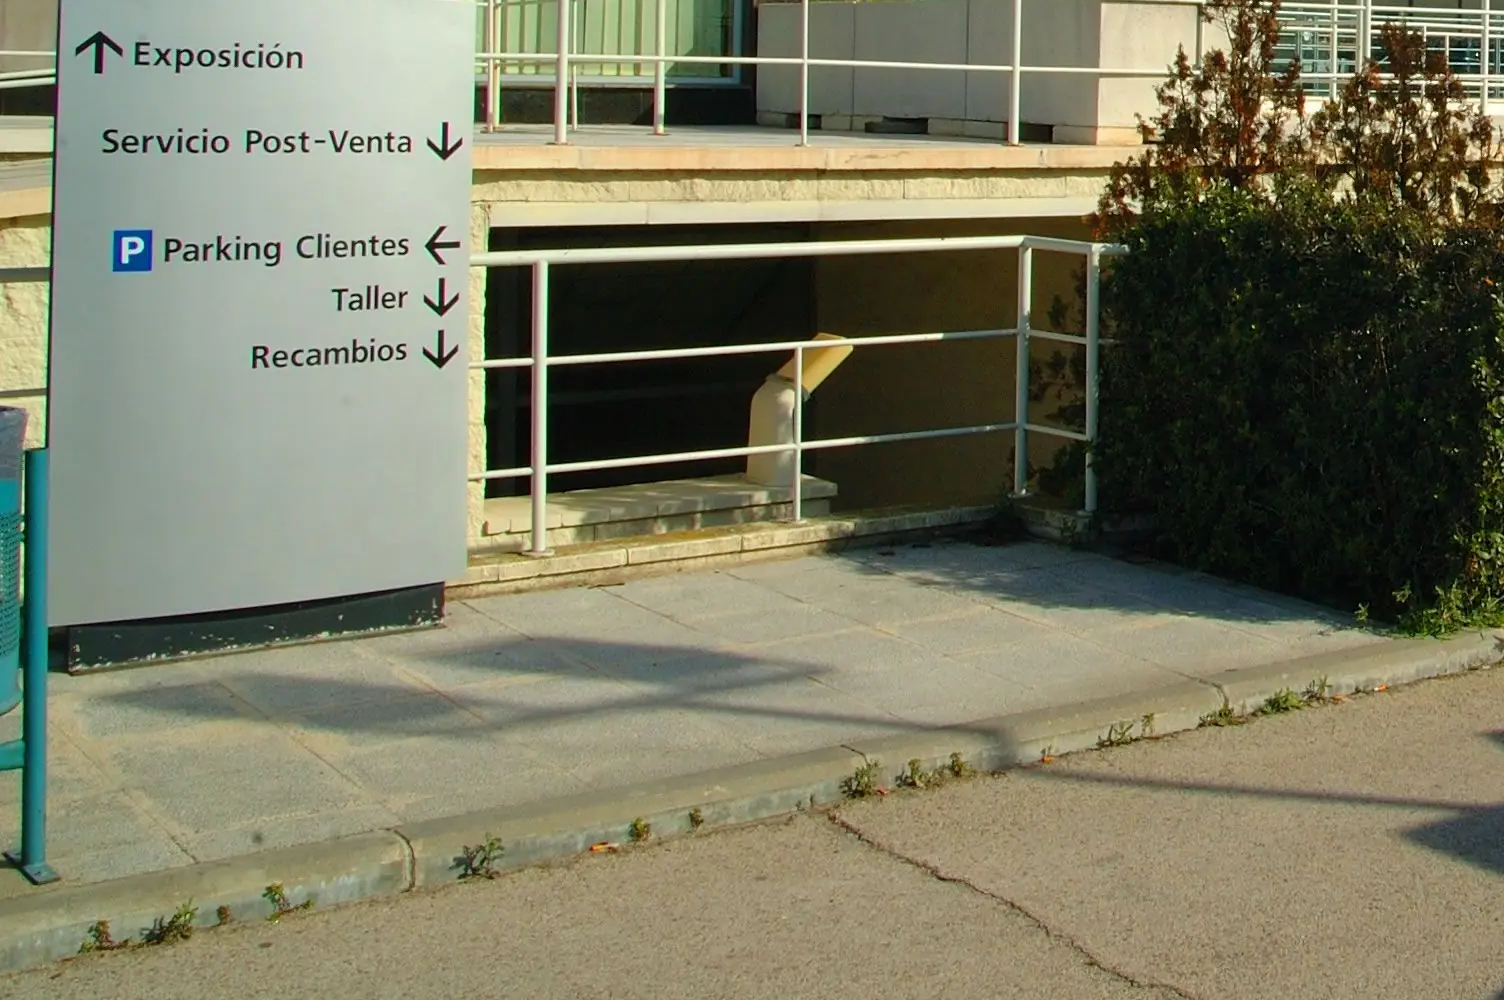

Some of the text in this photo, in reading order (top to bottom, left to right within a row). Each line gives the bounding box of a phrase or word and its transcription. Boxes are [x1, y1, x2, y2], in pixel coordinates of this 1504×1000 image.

[134, 42, 303, 74] Exposición
[102, 127, 412, 153] Servicio Post-Venta
[121, 233, 410, 267] P Parking Clientes
[331, 285, 409, 312] Taller
[252, 338, 408, 369] Recambios
